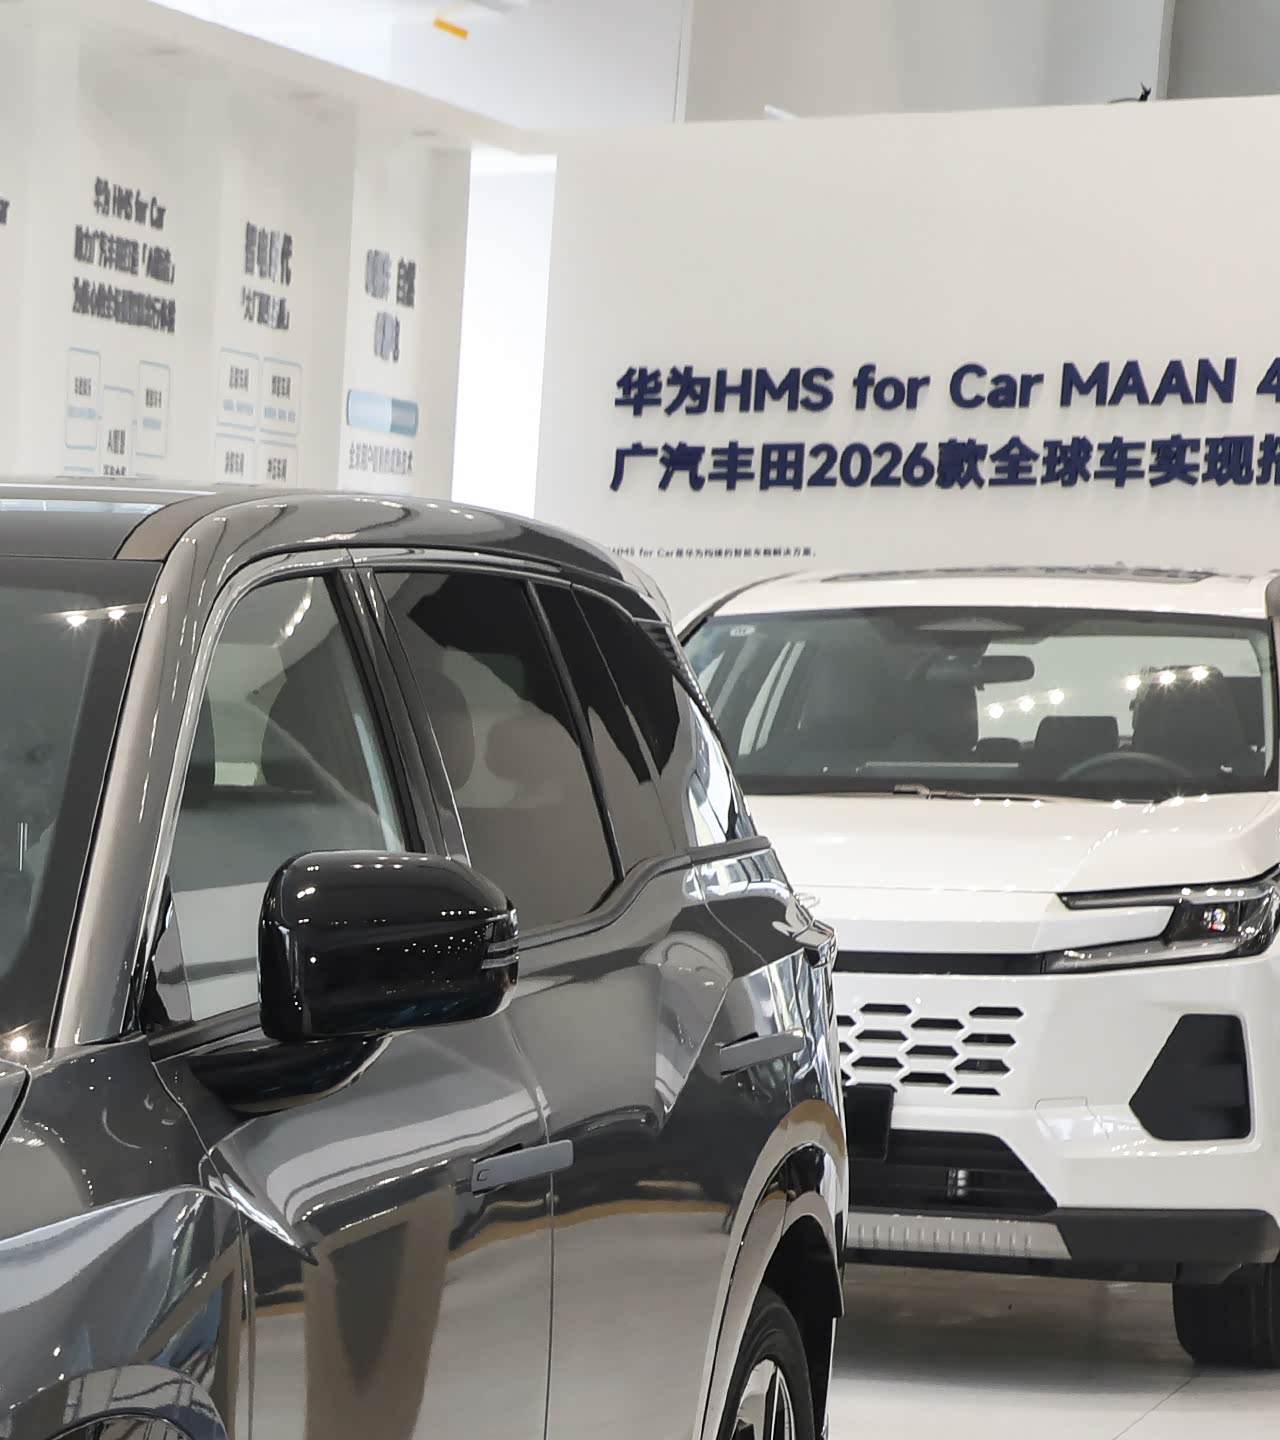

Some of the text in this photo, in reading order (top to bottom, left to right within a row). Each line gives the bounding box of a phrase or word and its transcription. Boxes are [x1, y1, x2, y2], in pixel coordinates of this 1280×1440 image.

[615, 366, 834, 416] 华为HMS
[853, 364, 930, 411] for
[950, 363, 1044, 410] Car
[1060, 358, 1236, 407] MAAN
